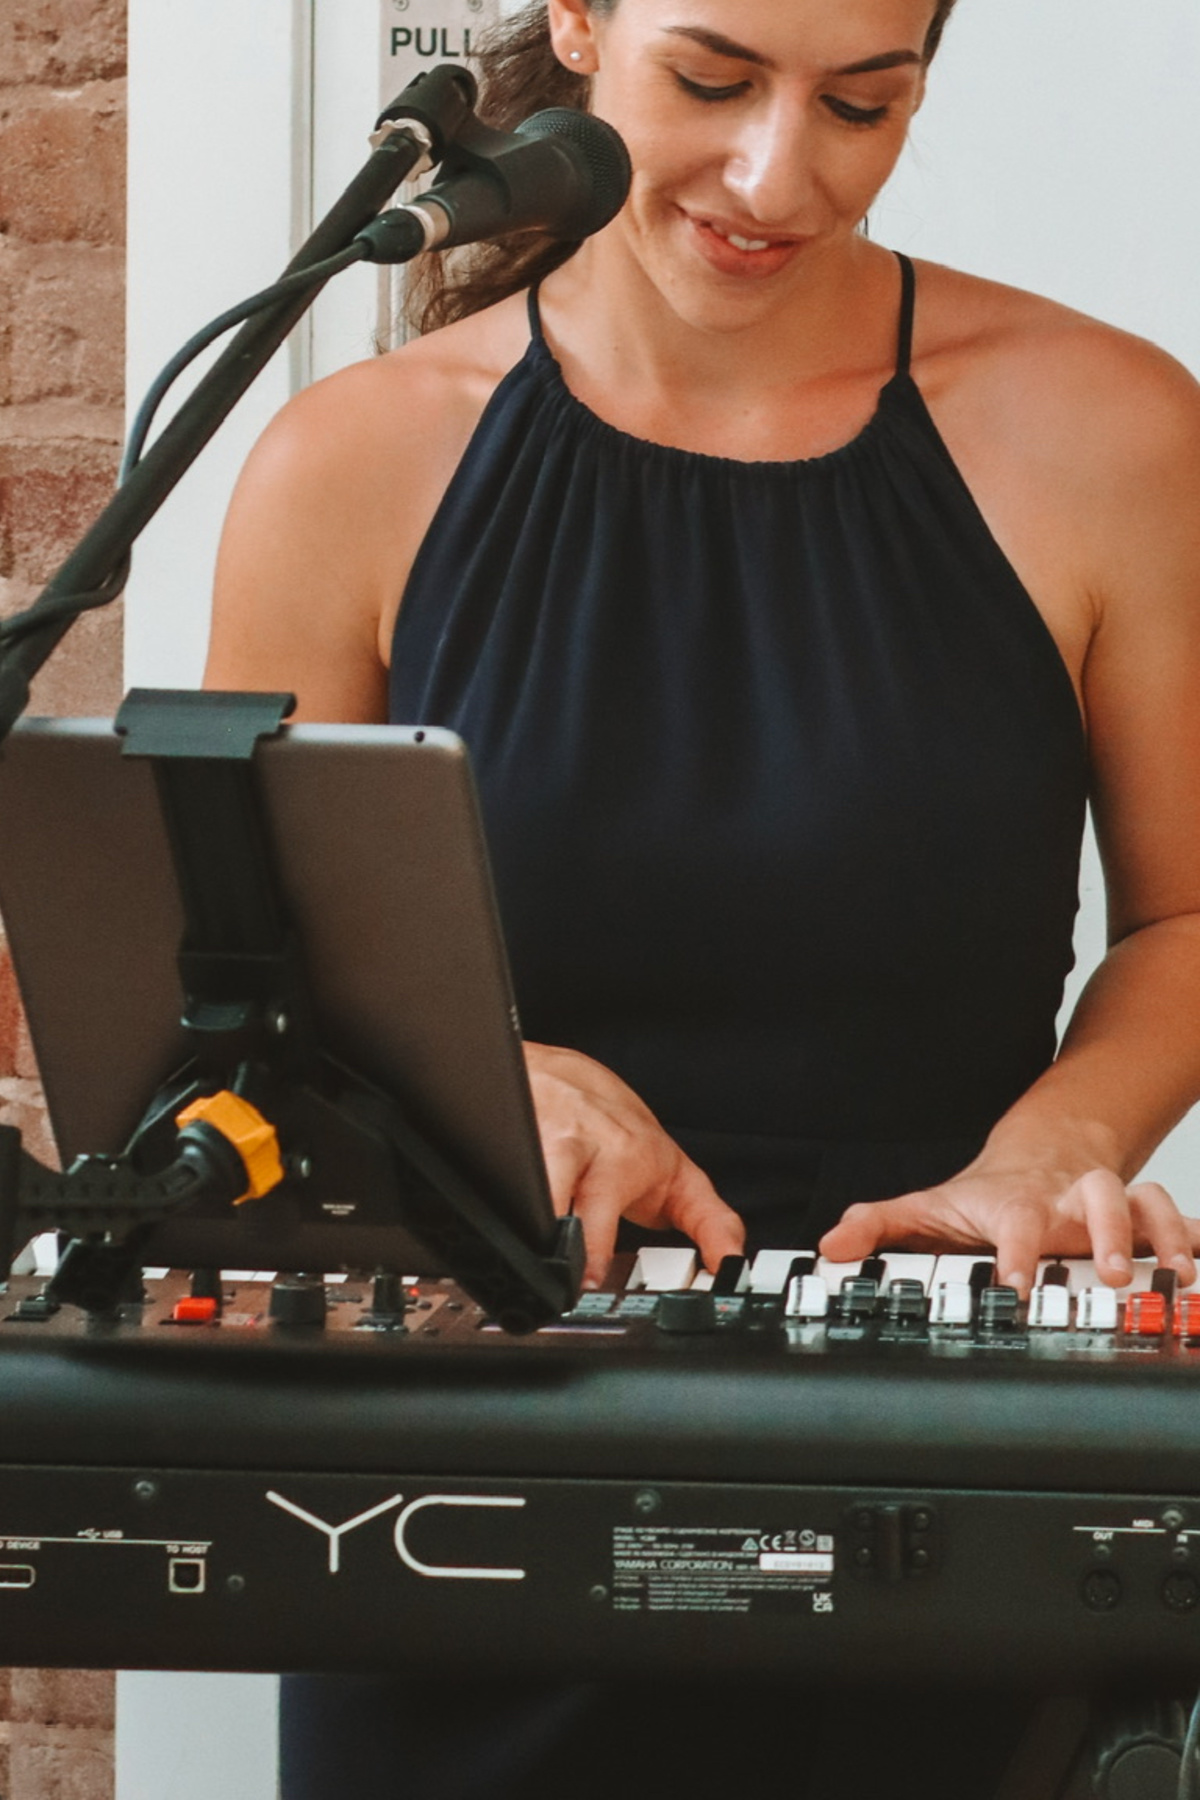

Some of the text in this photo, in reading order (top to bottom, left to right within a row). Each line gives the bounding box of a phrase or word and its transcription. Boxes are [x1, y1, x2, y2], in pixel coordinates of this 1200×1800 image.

[390, 27, 480, 57] PULL
[102, 1530, 124, 1540] USB
[265, 1489, 527, 1580] YC
[1093, 1531, 1114, 1541] OUT
[6, 1541, 41, 1551] DEVICE
[166, 1545, 180, 1554] TO
[613, 1560, 657, 1570] YAMAHA
[659, 1560, 734, 1571] CORPORATION
